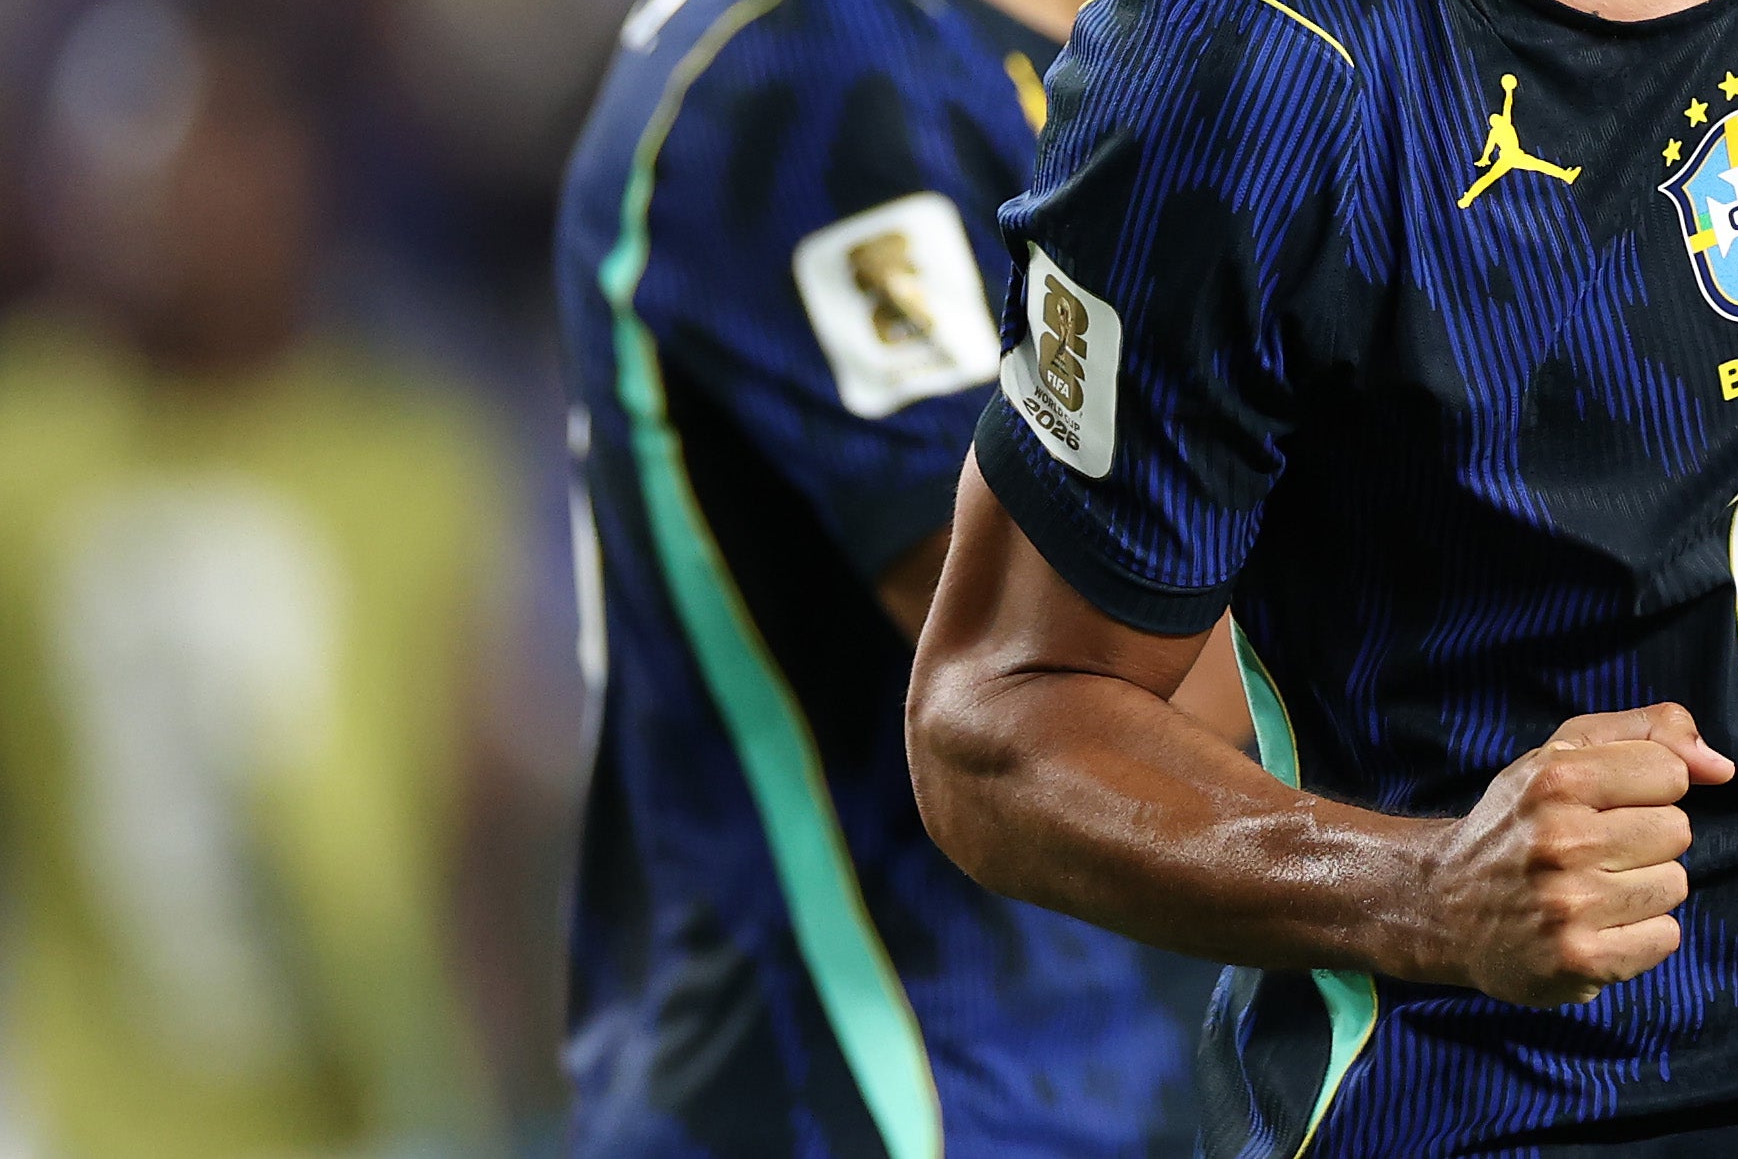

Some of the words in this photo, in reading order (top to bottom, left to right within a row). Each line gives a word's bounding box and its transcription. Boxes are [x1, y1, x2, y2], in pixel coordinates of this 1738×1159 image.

[1046, 369, 1070, 399] FIFA
[1022, 397, 1081, 451] 2026
[1034, 385, 1064, 417] WORLD
[1063, 413, 1081, 432] CUP
